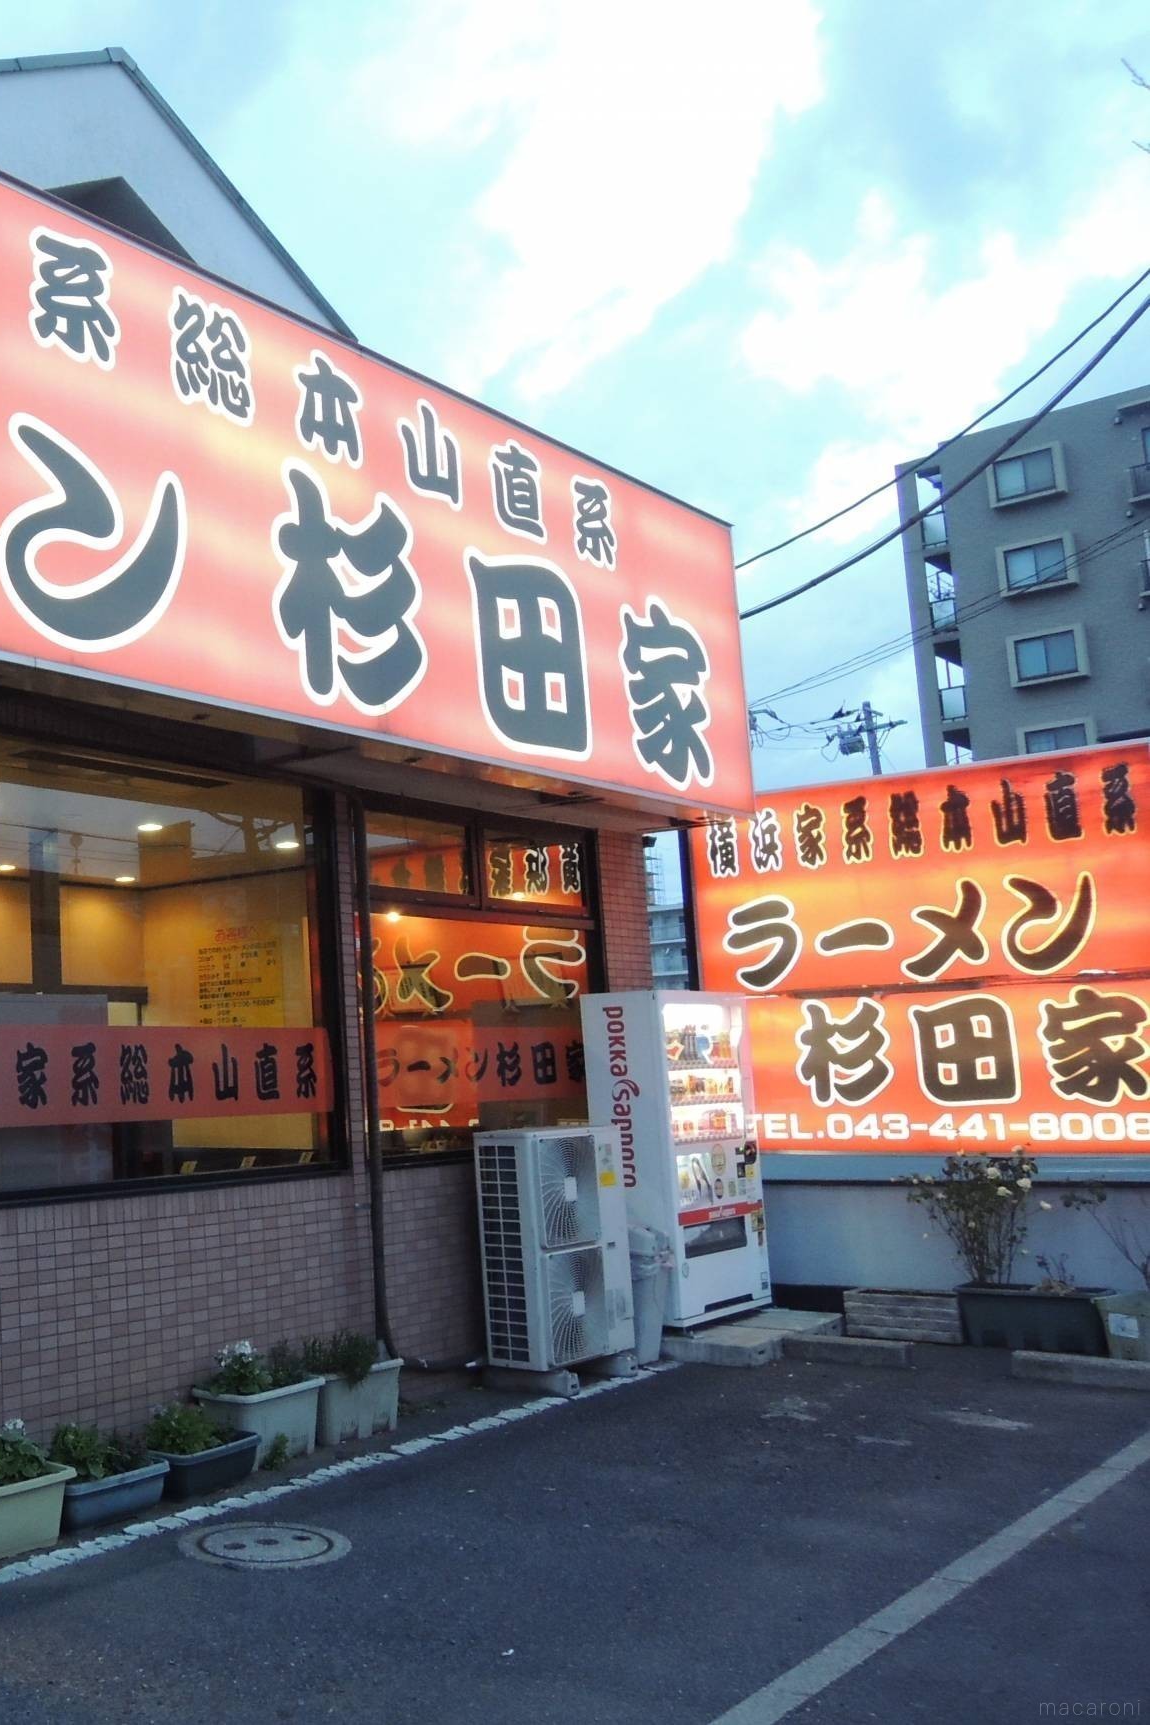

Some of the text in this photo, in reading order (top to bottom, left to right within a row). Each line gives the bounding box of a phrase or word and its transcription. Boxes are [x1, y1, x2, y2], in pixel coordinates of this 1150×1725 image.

[723, 871, 1097, 992] ラーメン
[795, 985, 1150, 1107] 杉田家
